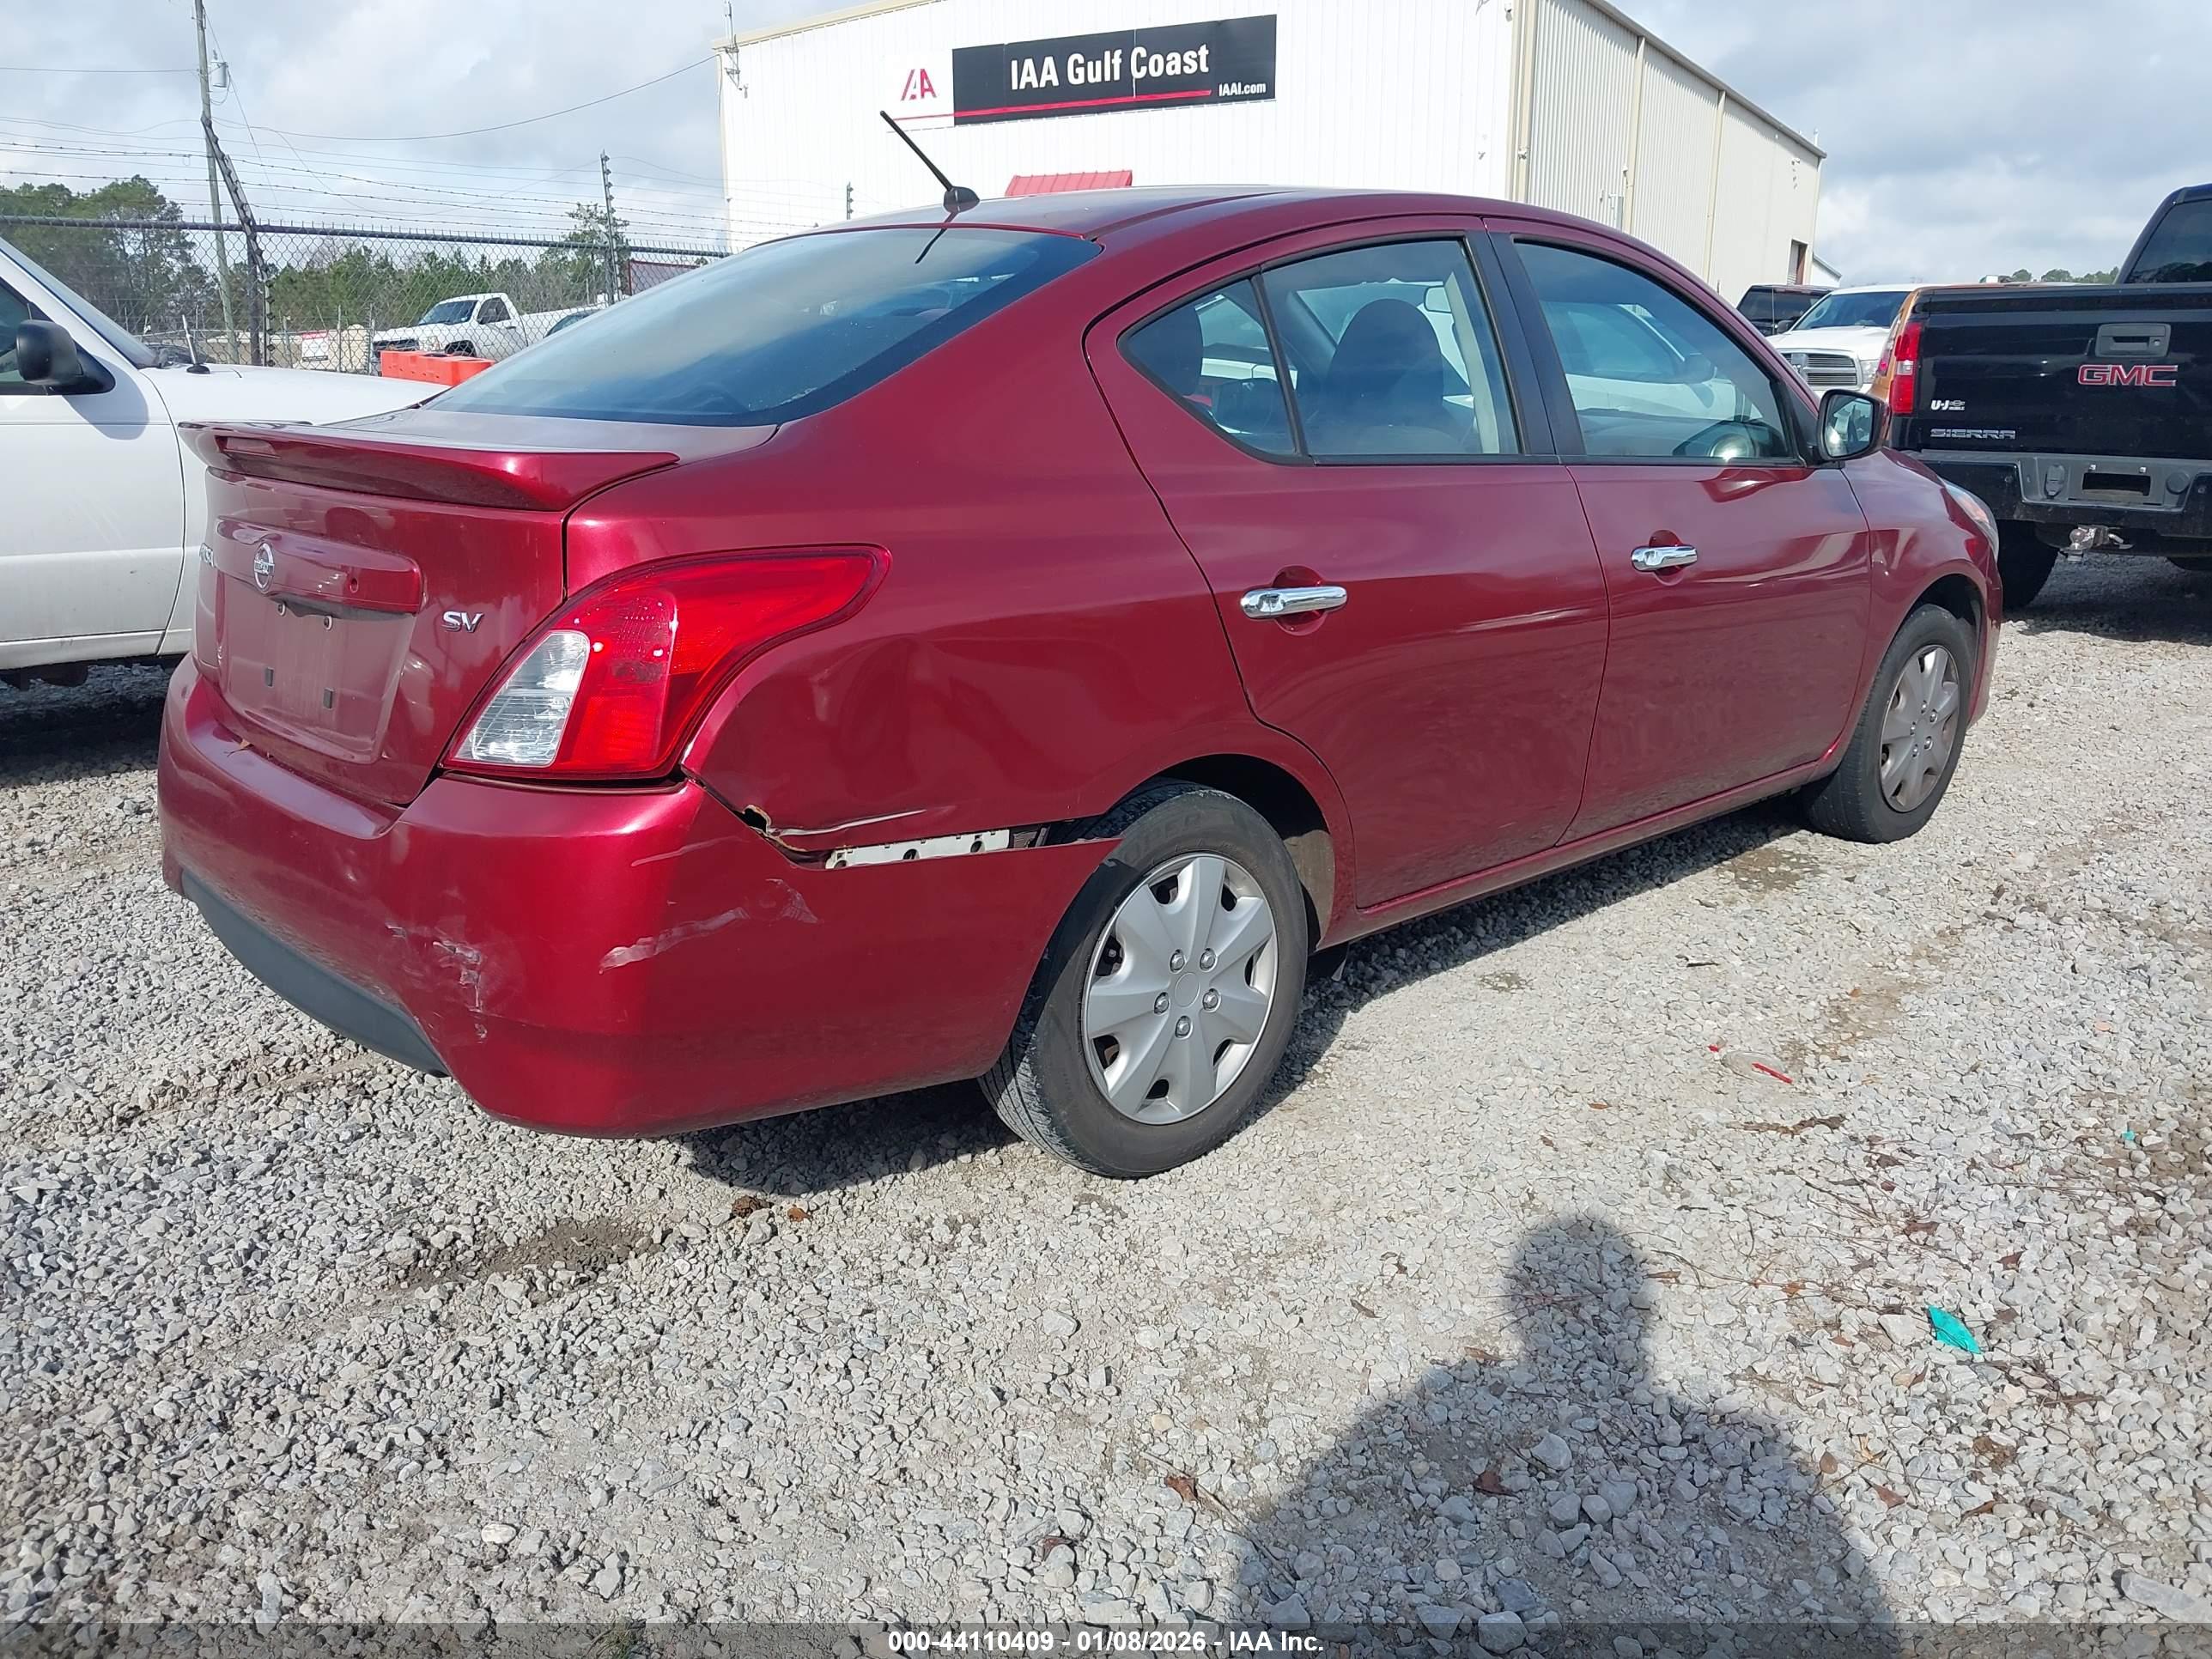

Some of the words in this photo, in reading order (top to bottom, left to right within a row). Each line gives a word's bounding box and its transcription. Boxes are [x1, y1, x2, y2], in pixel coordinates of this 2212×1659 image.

[1011, 57, 1059, 90] IAA
[1067, 49, 1122, 85] Gulf
[1130, 45, 1209, 79] Coast
[2078, 364, 2179, 386] GMC
[1930, 428, 2016, 440] SIERRA
[441, 611, 484, 633] SV
